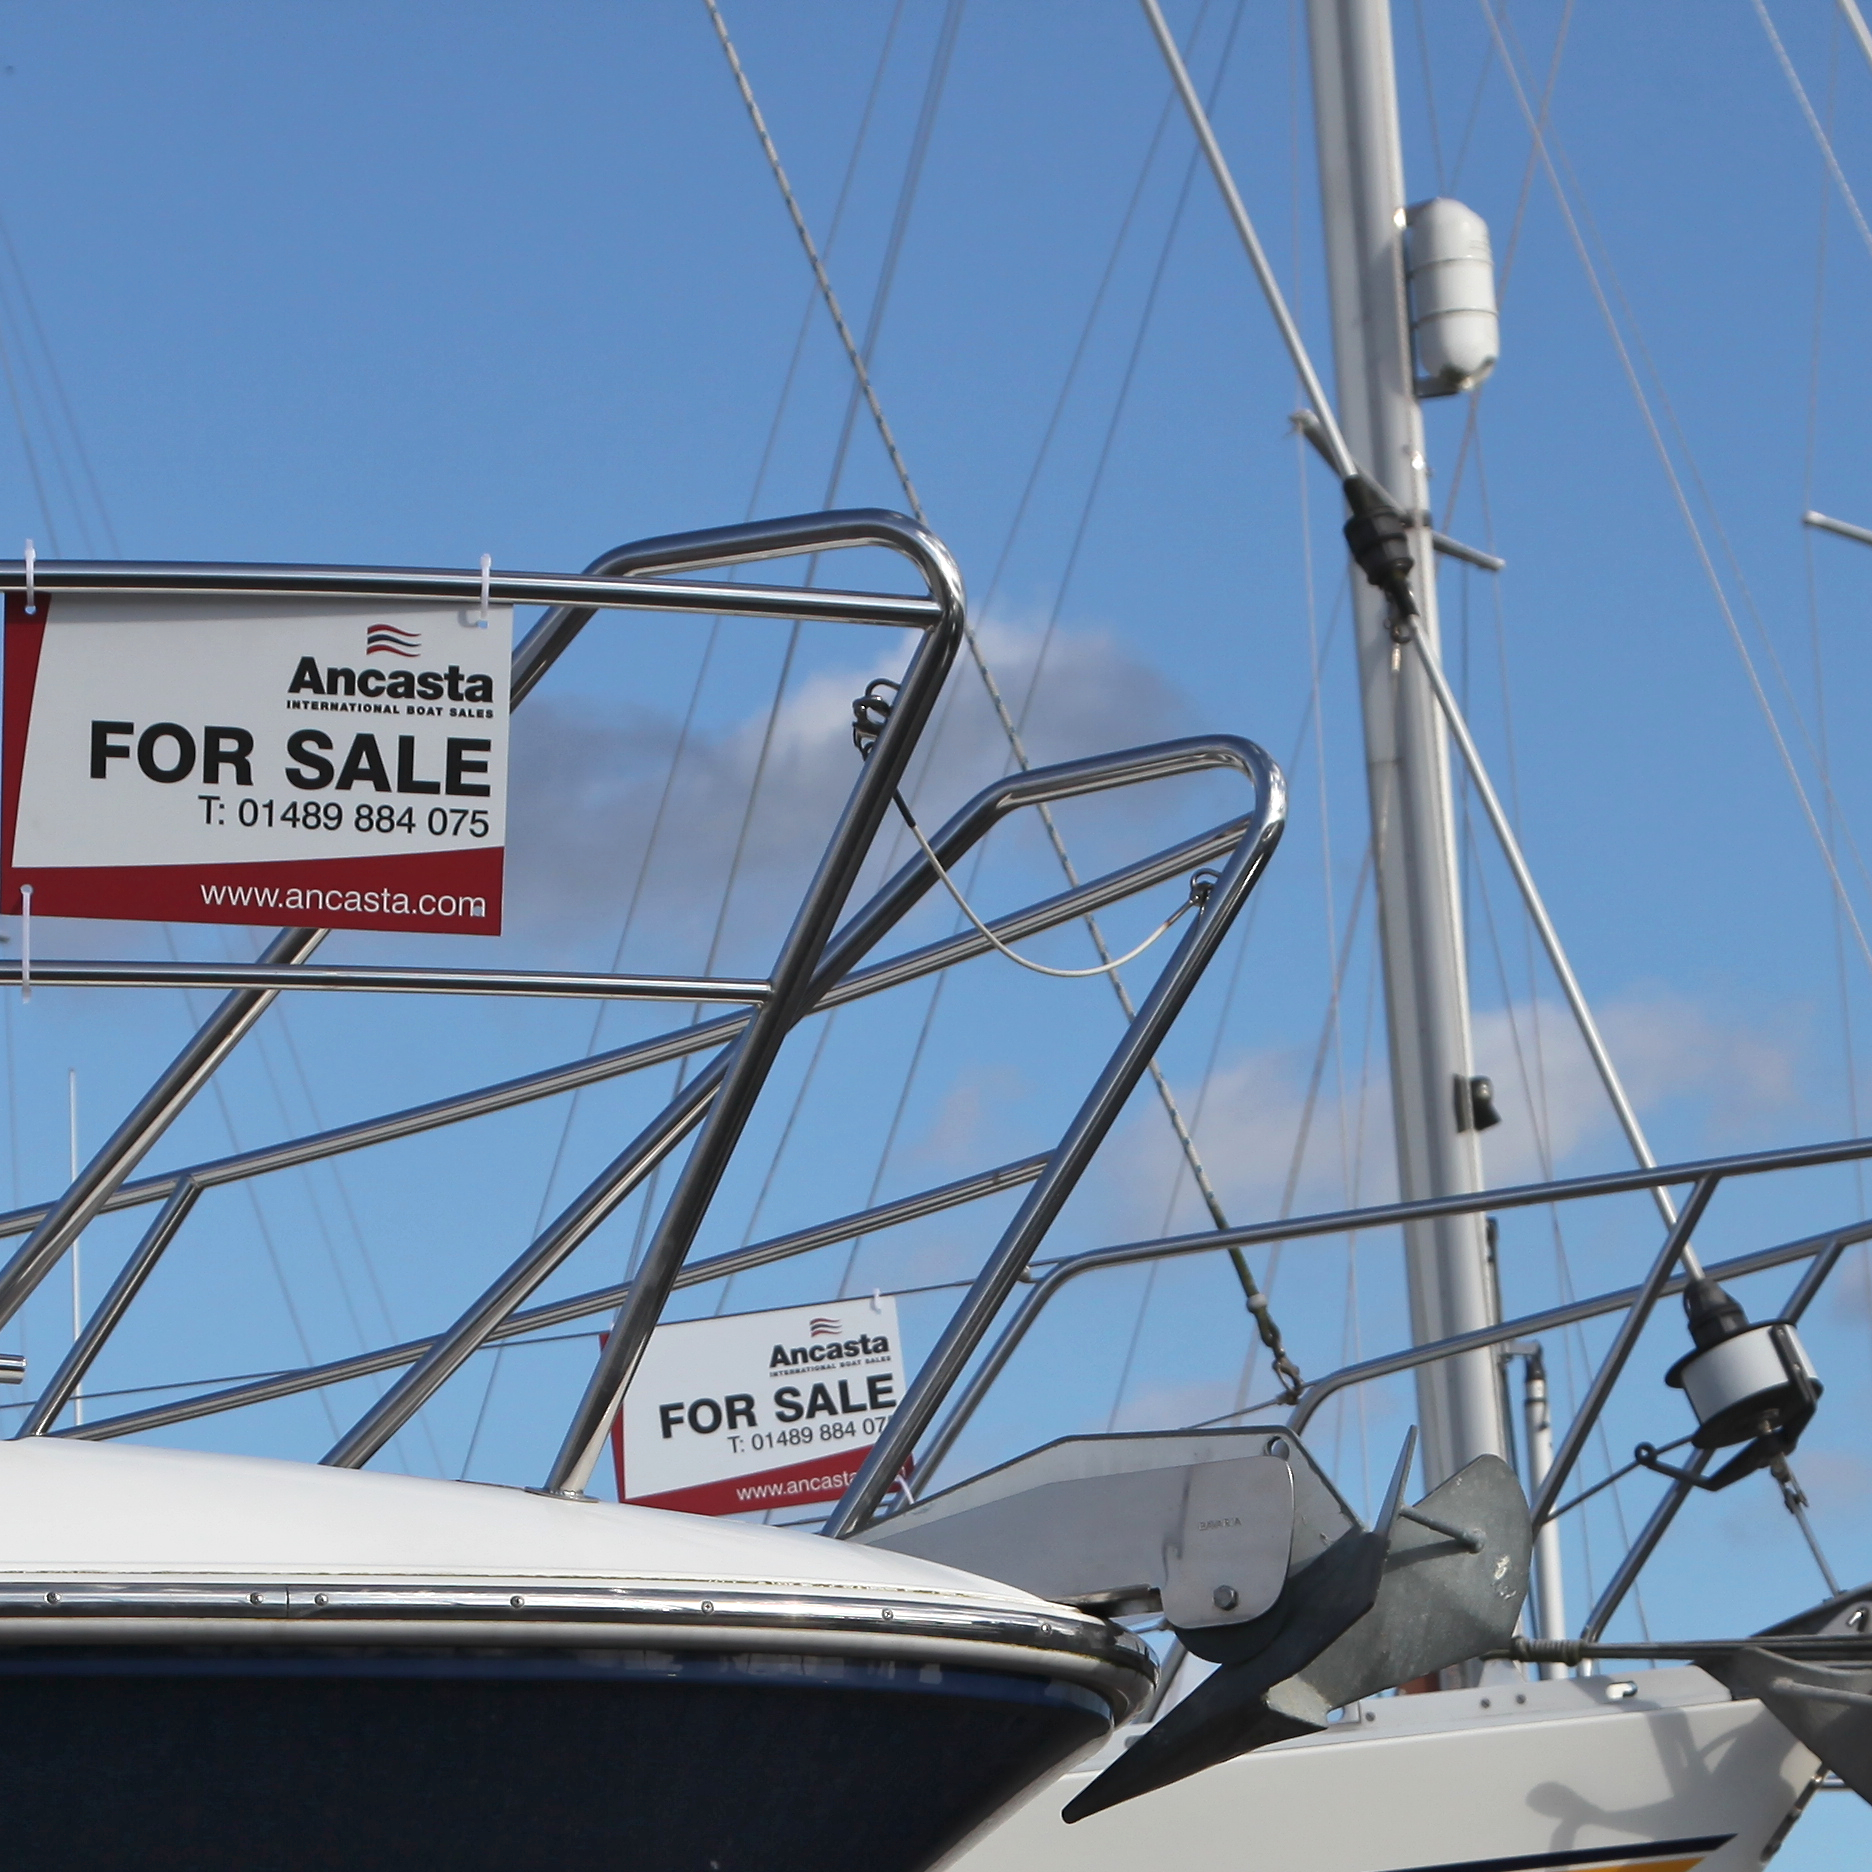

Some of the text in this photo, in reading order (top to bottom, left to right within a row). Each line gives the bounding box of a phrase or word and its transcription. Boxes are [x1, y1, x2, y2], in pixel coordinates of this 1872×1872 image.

[288, 656, 493, 704] Ancasta
[286, 699, 494, 719] INTERNATIONAL BOAT SALES
[89, 720, 492, 797] FOR SALE
[198, 795, 490, 838] T: 01489 884 075
[201, 884, 487, 918] www.ancasta.com
[769, 1333, 889, 1368] Ancasta
[659, 1373, 897, 1439] FOR SALE
[727, 1435, 746, 1454] T:
[751, 1427, 814, 1451] 01489
[820, 1420, 857, 1442] 884
